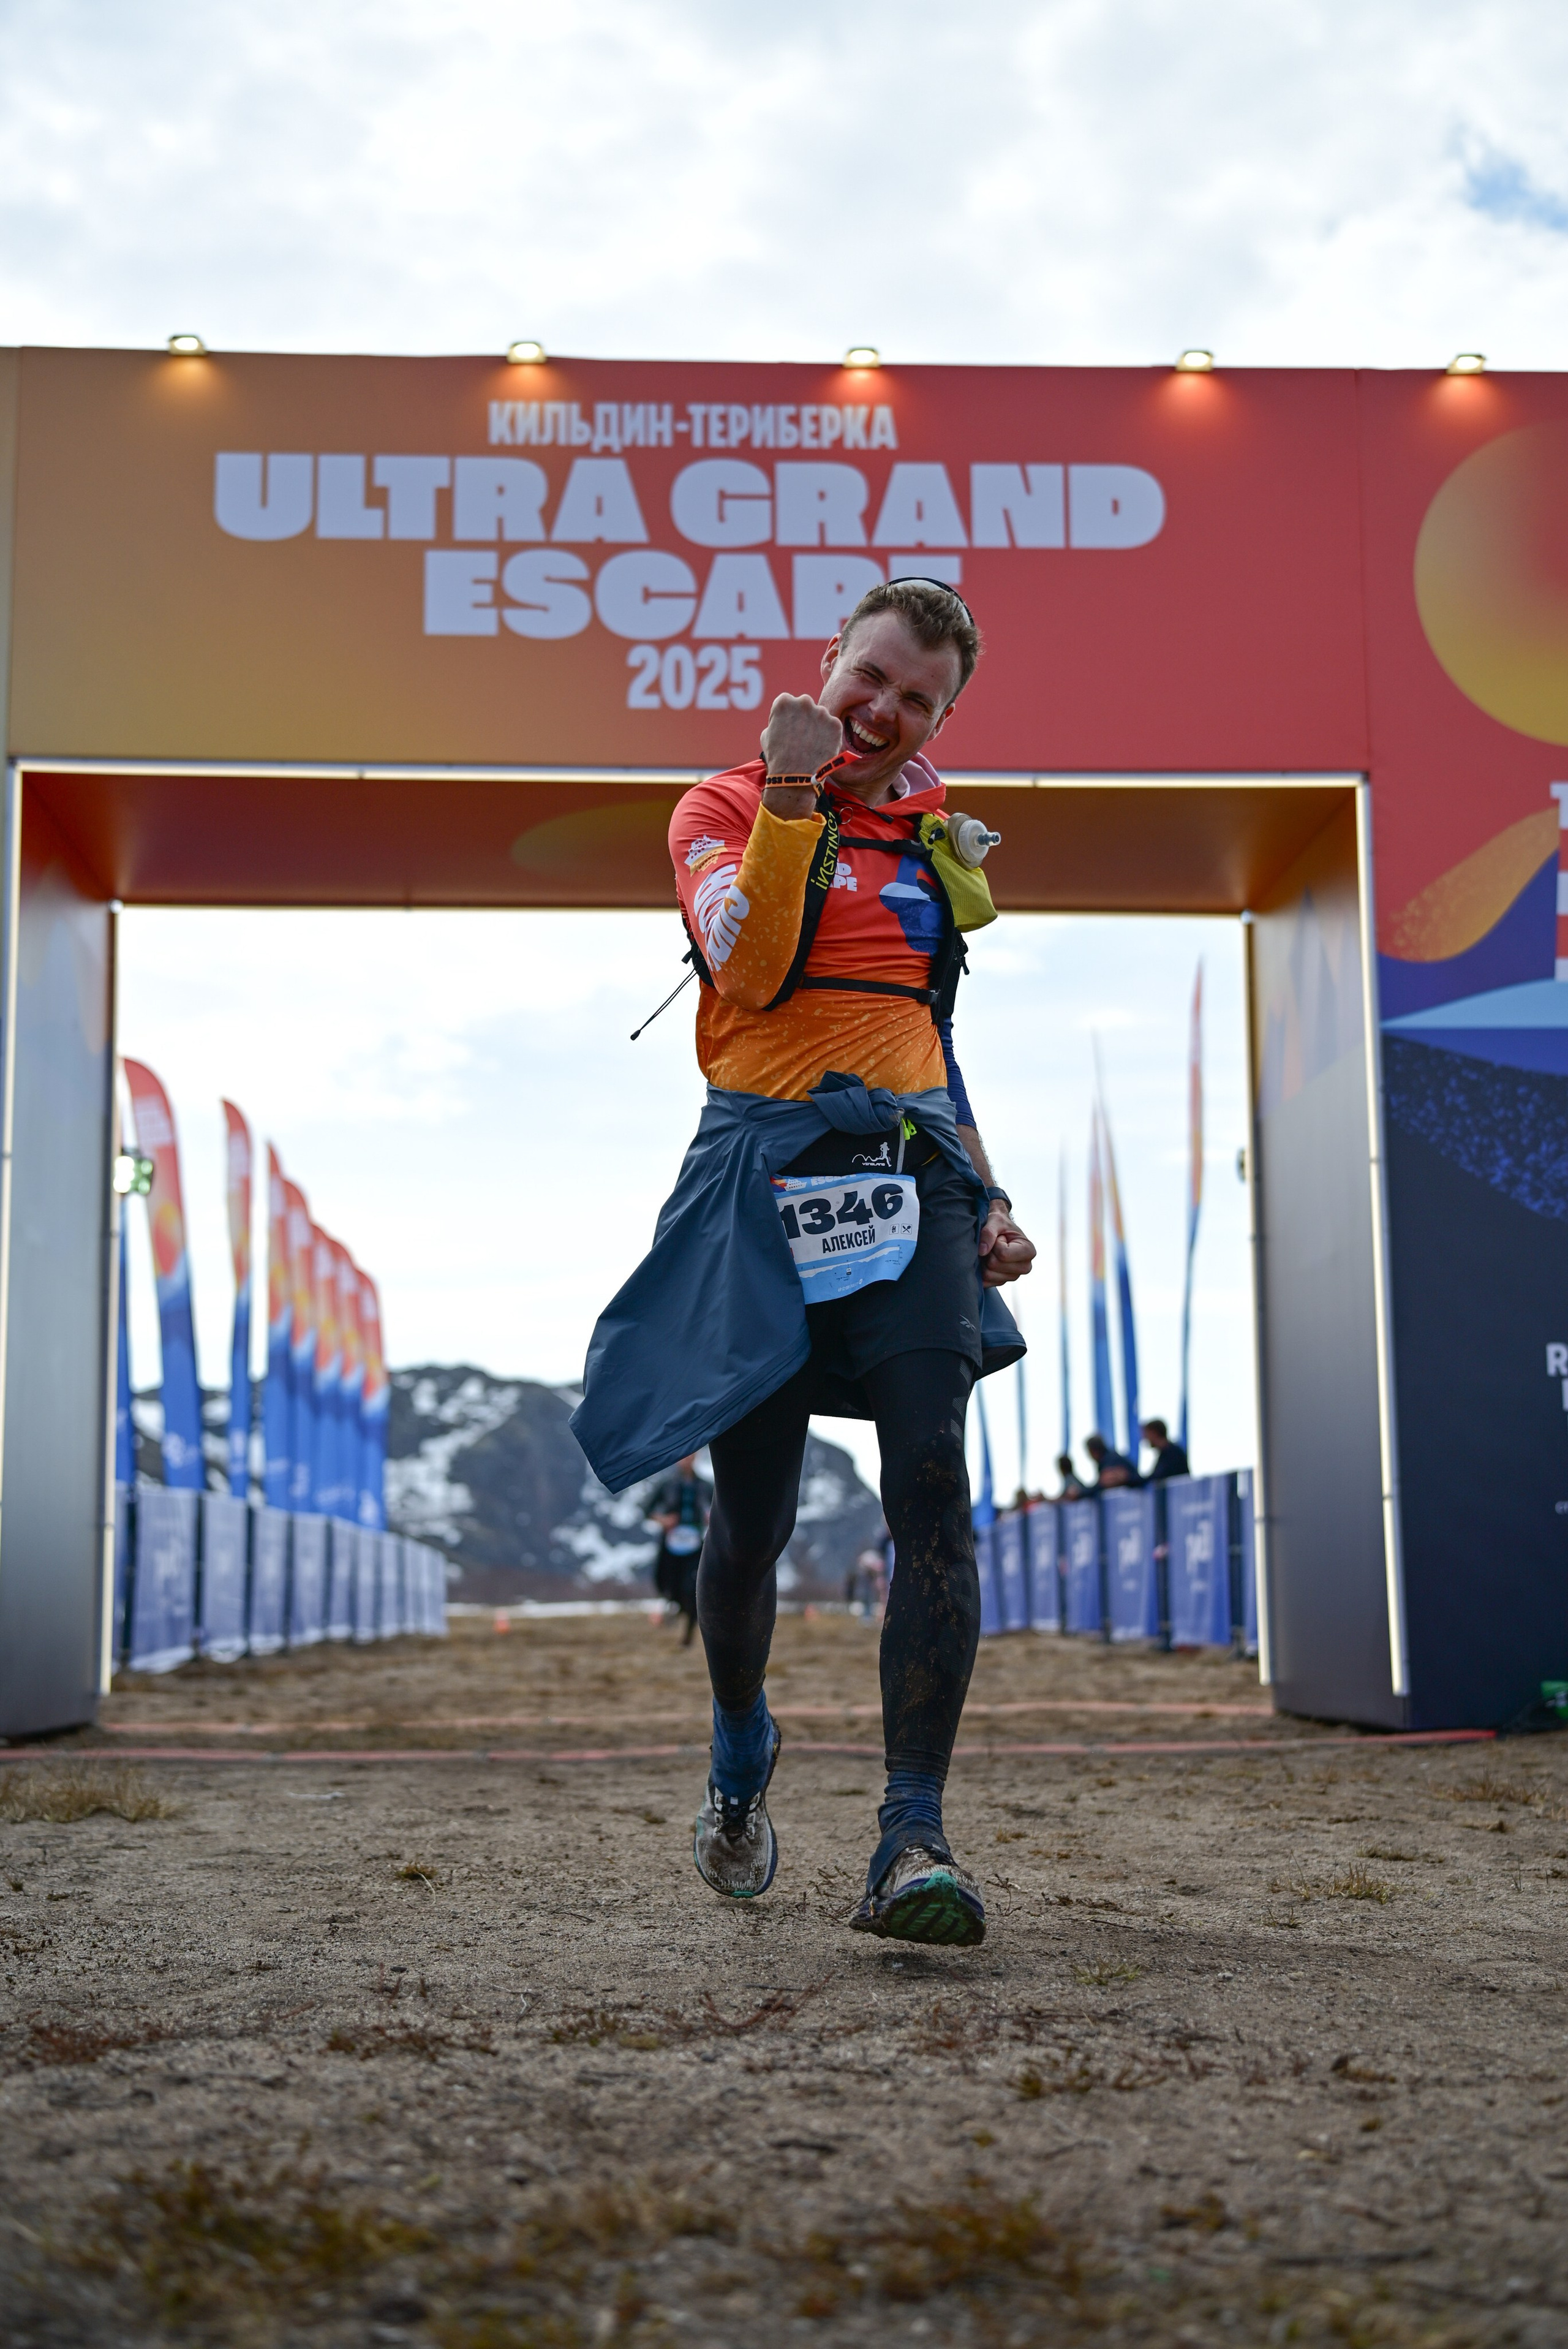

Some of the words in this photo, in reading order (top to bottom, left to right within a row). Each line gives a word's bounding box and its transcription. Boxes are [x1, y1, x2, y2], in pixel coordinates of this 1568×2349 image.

[489, 401, 899, 452] КИЛЬДИН-ТЕРИБЕРКА
[214, 452, 649, 543] ULTRA
[670, 457, 1166, 549] GRAND
[423, 548, 962, 640] ESCAP
[627, 643, 764, 711] 2025
[810, 1174, 857, 1186] ESC
[779, 1183, 903, 1239] 1346
[822, 1225, 875, 1254] АЛЕКСЕЙ
